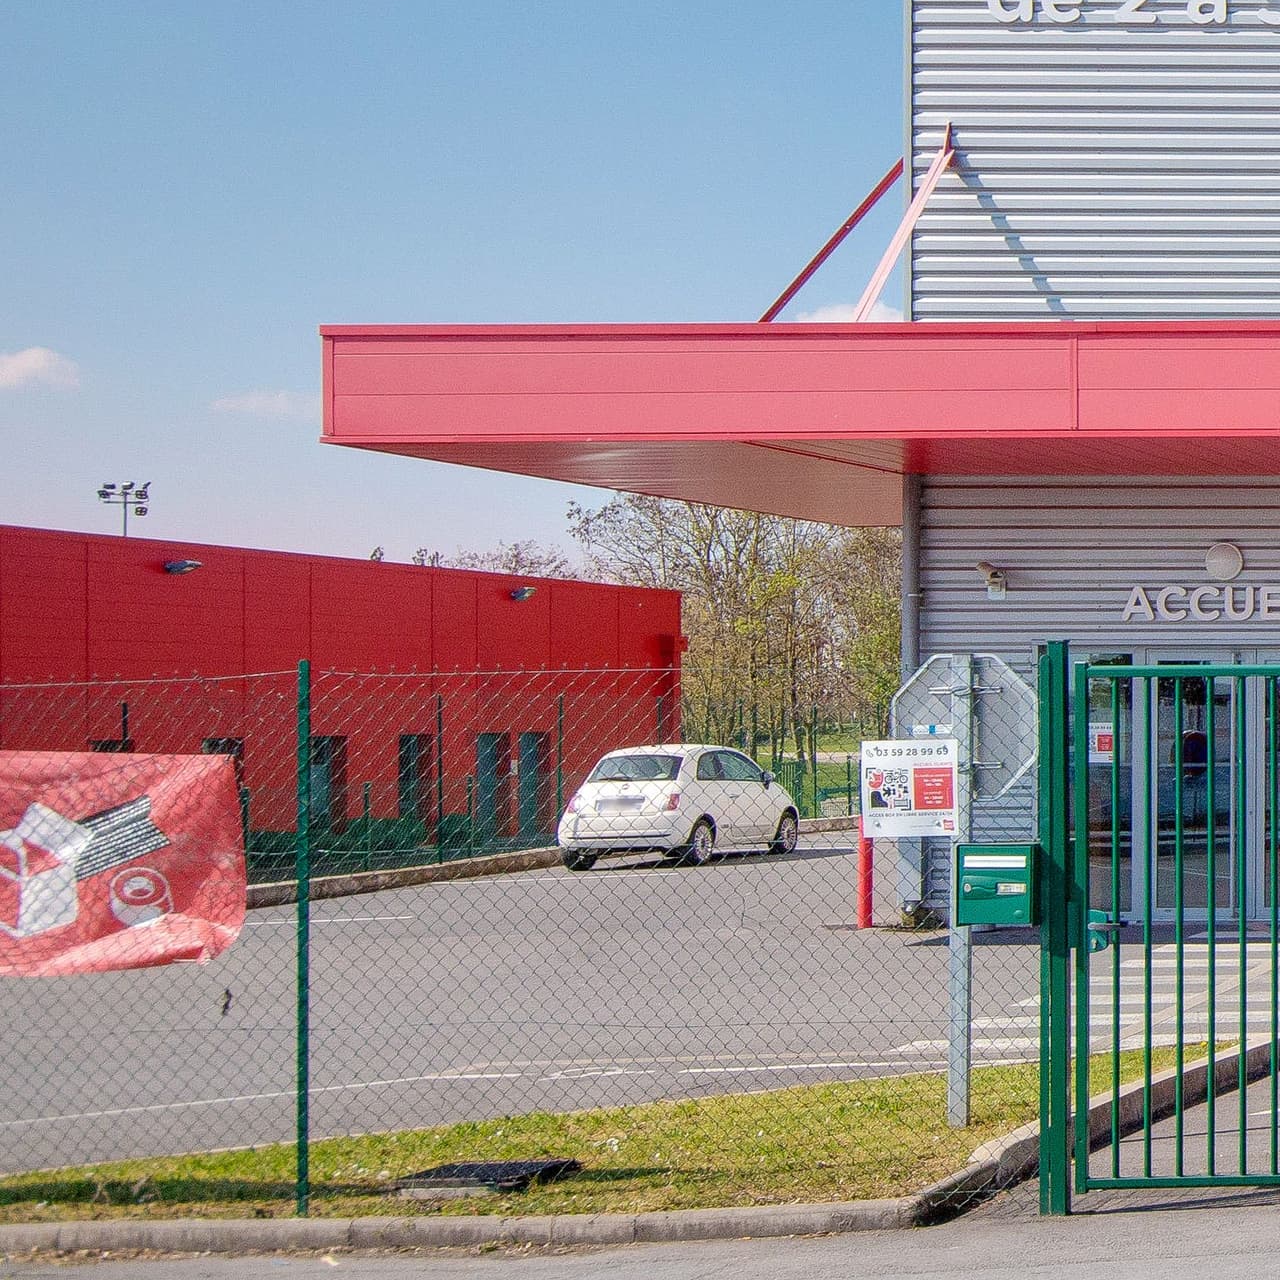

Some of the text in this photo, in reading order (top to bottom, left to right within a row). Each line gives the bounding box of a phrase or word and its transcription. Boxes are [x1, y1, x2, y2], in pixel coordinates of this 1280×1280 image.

[876, 747, 949, 756] 03 59 28 99 69
